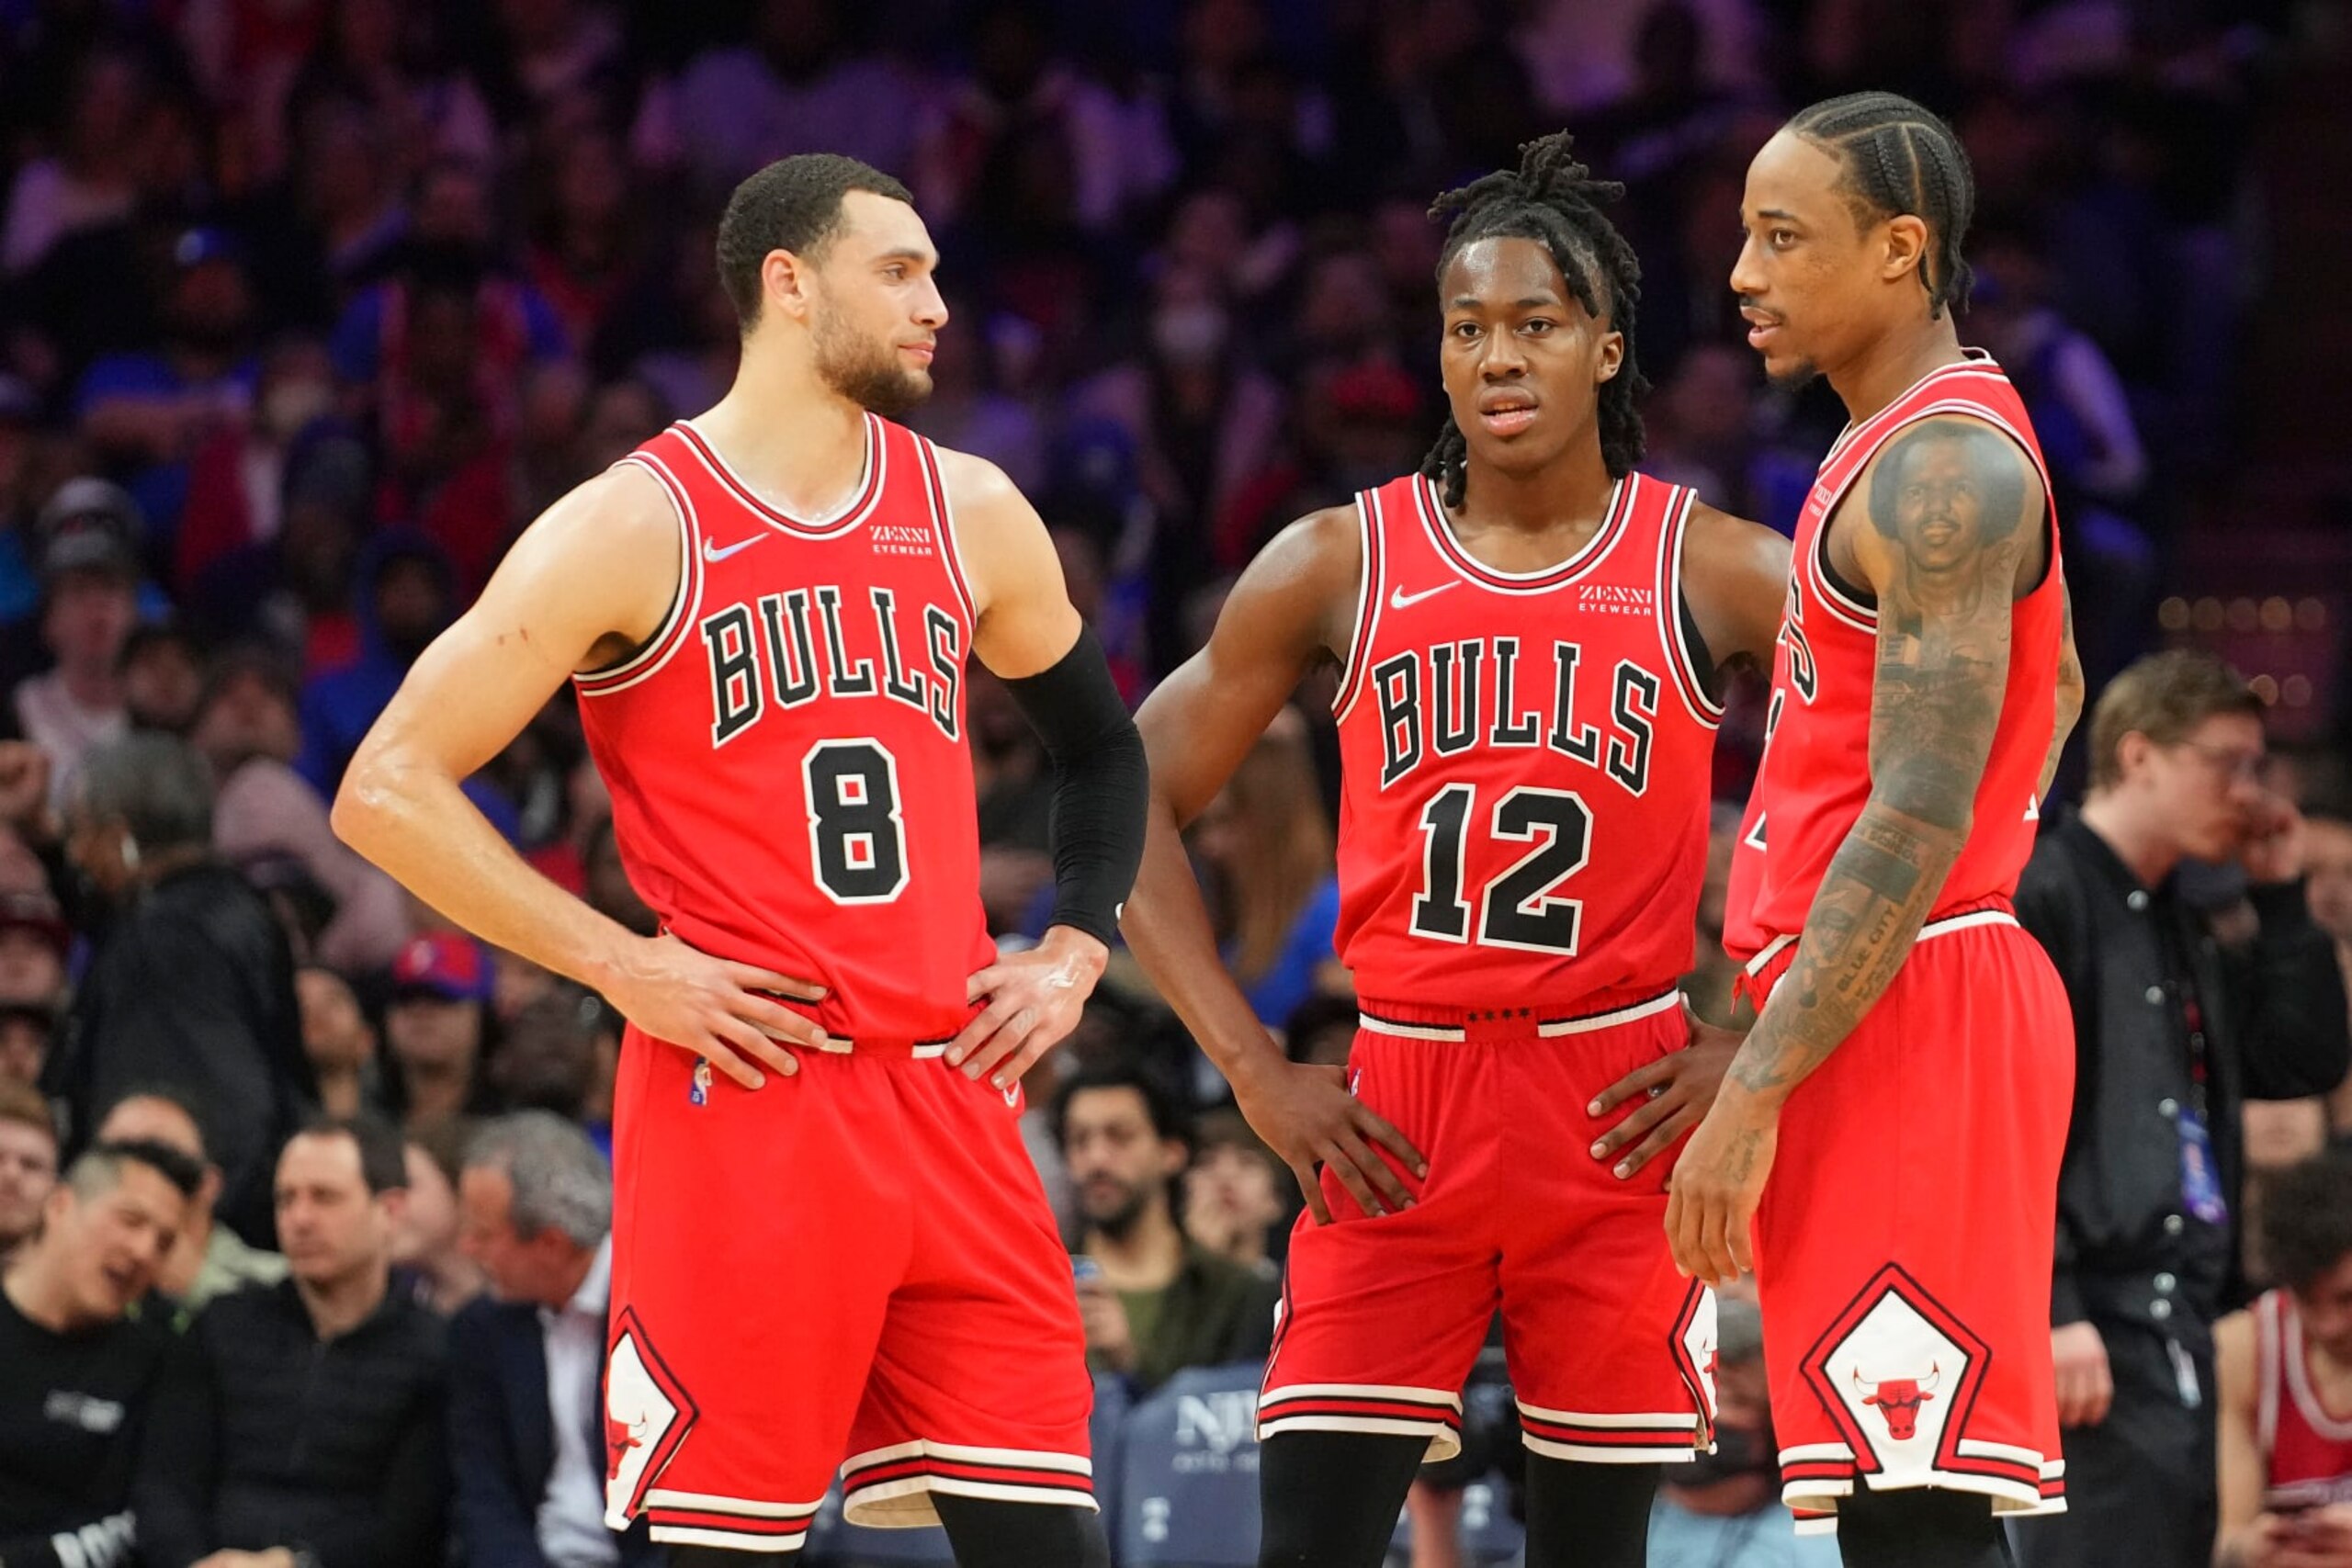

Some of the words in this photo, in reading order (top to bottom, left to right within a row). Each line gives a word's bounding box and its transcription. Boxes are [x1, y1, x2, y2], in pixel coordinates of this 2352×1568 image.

[869, 525, 932, 543] ZENNI
[872, 544, 933, 556] EYEWEAR
[1578, 584, 1652, 604] ZENNI
[1578, 603, 1652, 616] EYEWEAR
[699, 585, 960, 750] BULLS
[1371, 637, 1661, 798] BULLS
[801, 737, 910, 906] 8
[1408, 783, 1594, 956] 12
